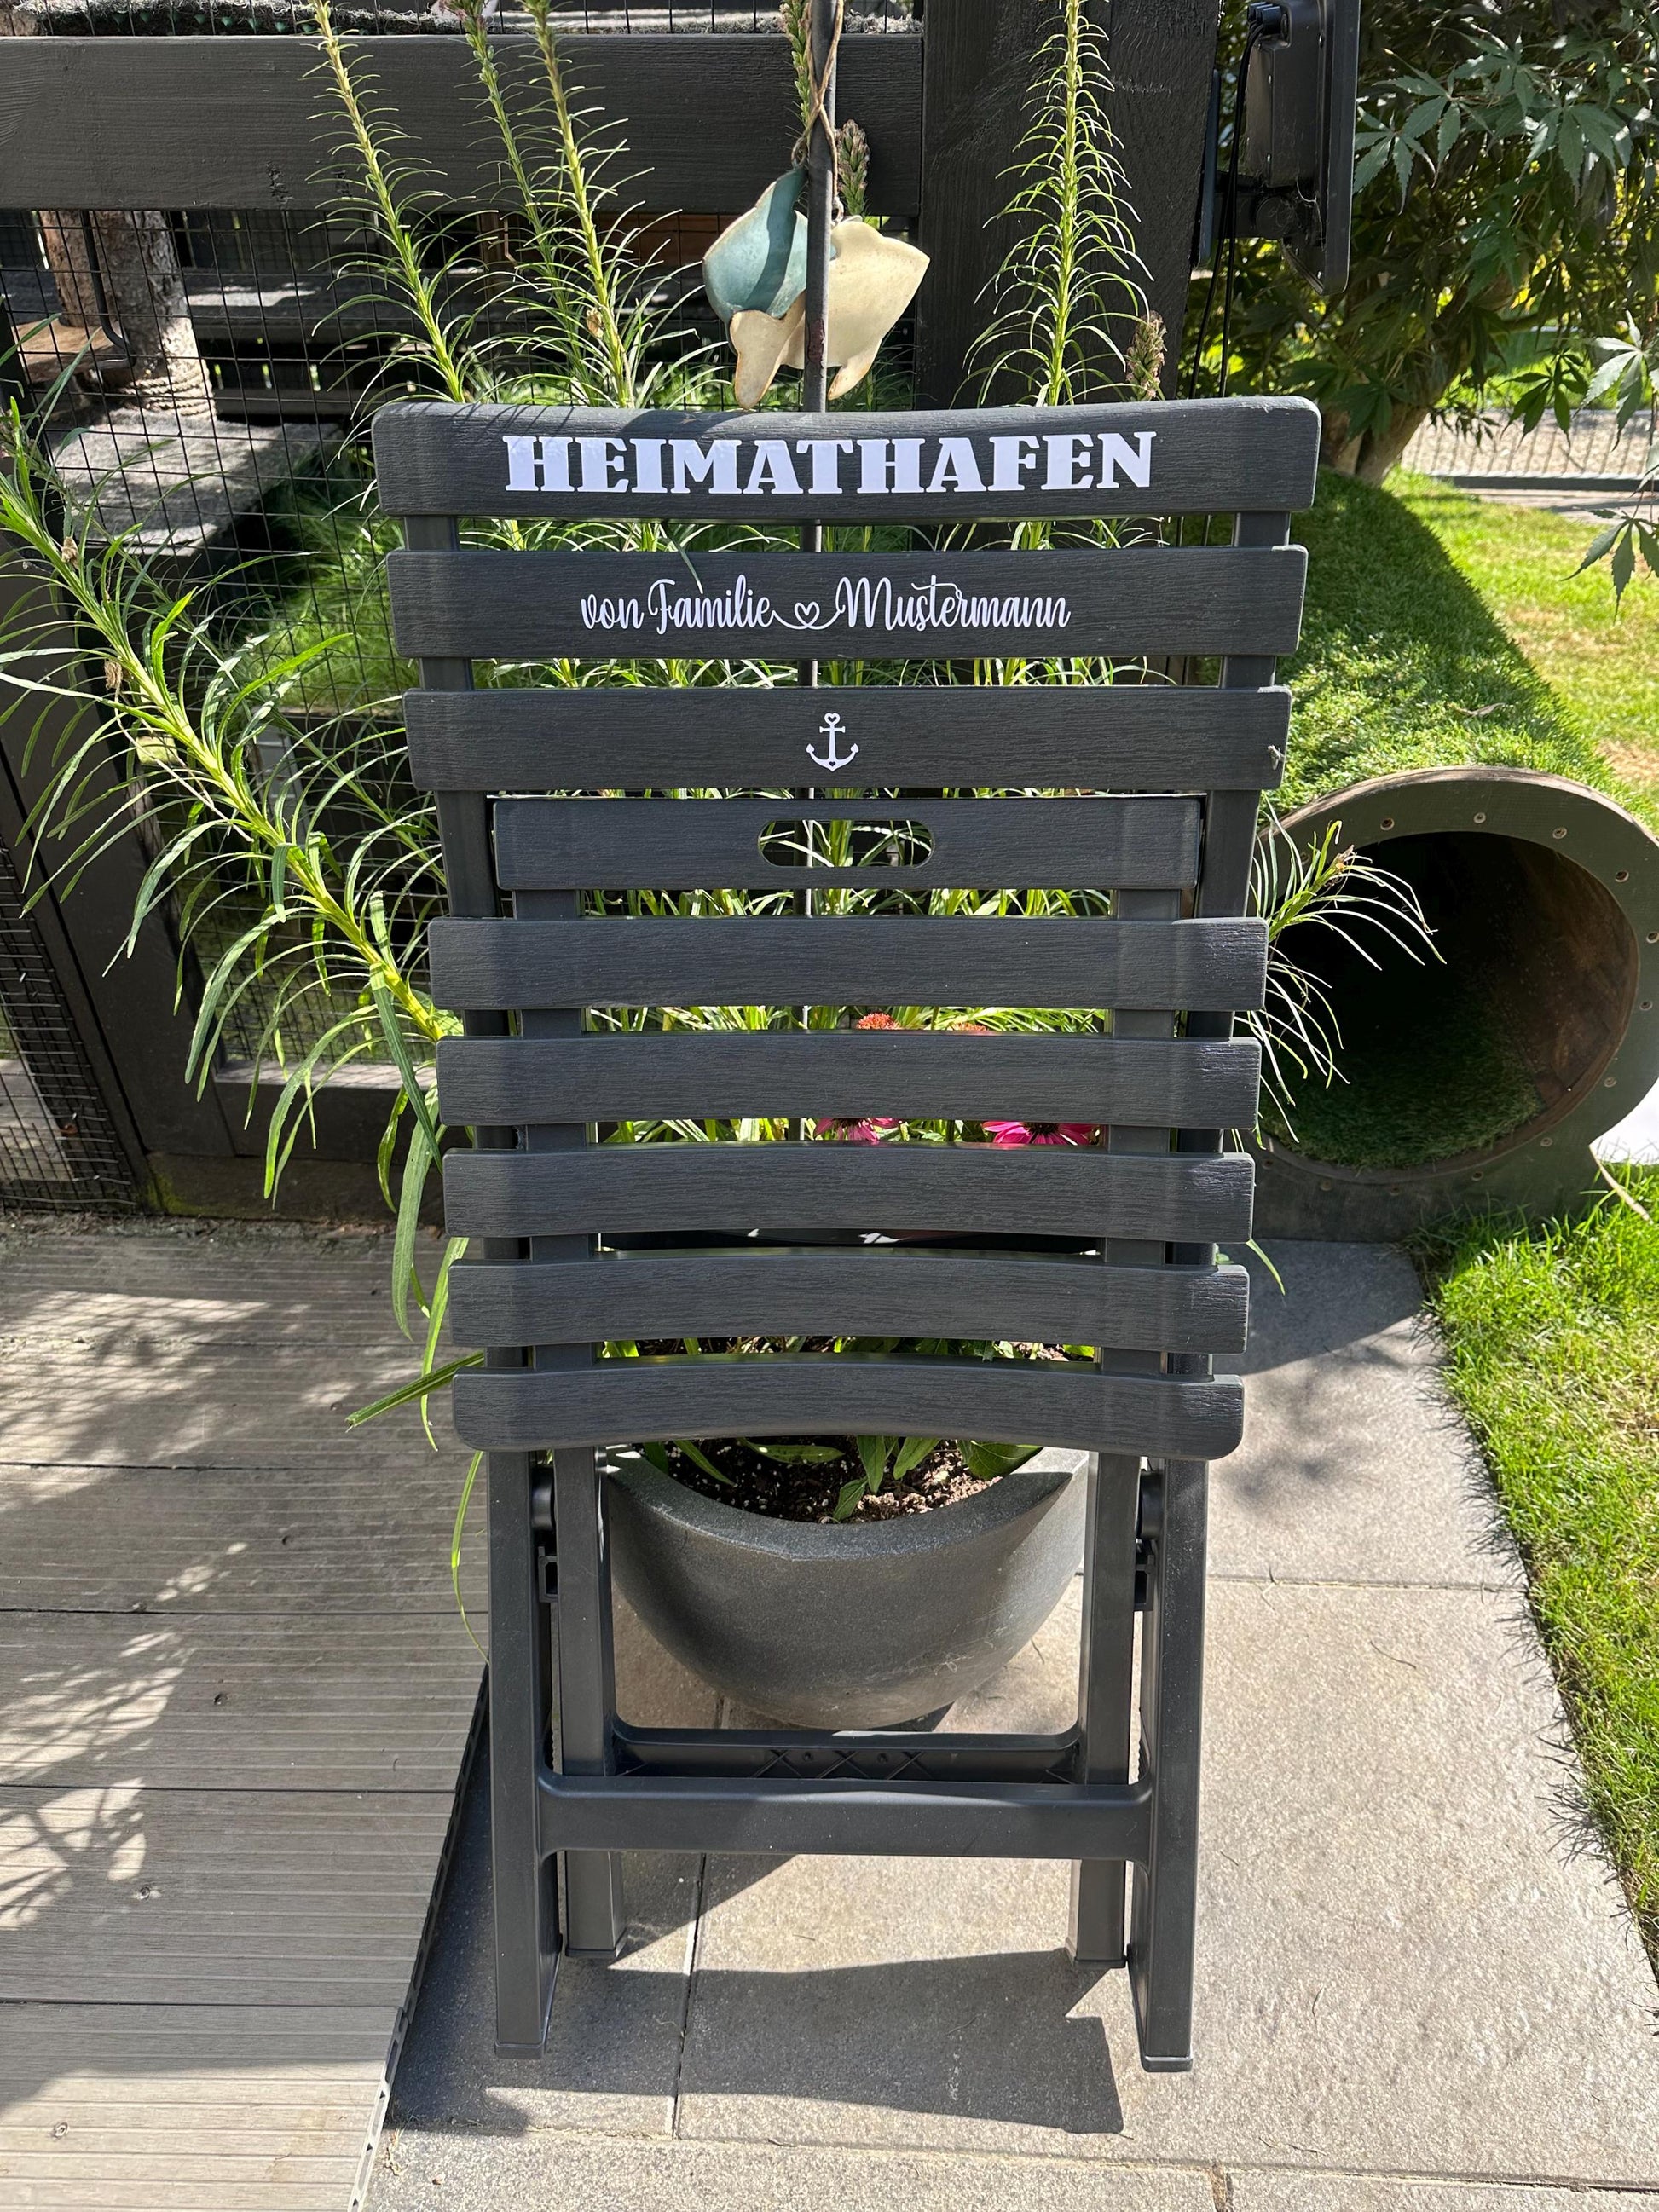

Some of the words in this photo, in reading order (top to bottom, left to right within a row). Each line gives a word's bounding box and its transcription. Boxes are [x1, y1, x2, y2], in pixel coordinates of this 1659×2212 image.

[503, 430, 1158, 494] HEIMATHAFEN
[580, 593, 644, 630] von
[647, 574, 775, 635] Familie
[835, 574, 1072, 632] Mustermann
